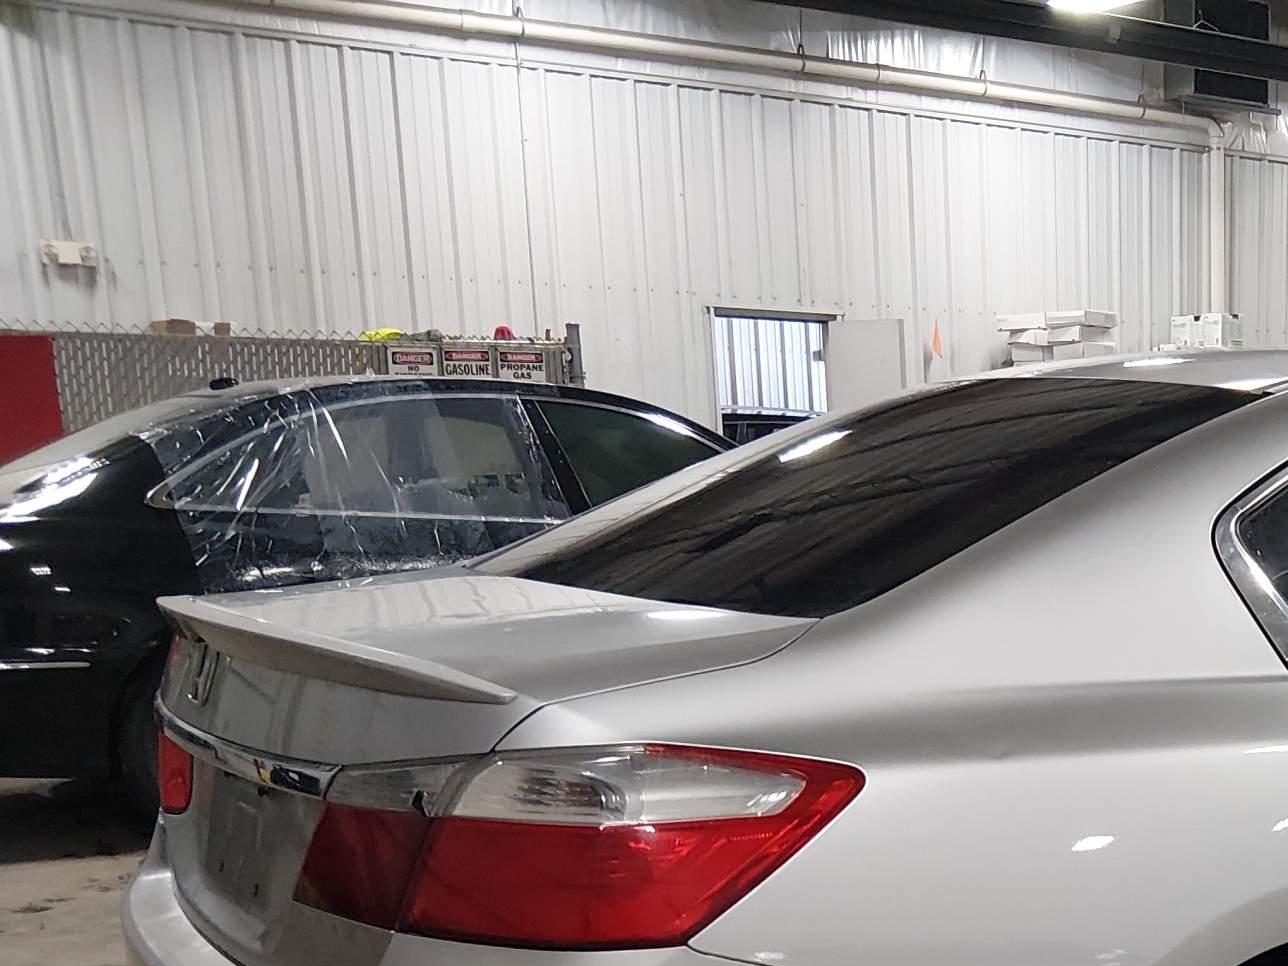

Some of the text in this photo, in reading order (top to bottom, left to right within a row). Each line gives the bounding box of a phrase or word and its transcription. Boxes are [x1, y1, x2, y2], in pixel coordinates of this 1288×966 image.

[395, 353, 430, 362] DANGER
[445, 363, 490, 375] GASOLINE
[500, 364, 544, 372] PROPANE
